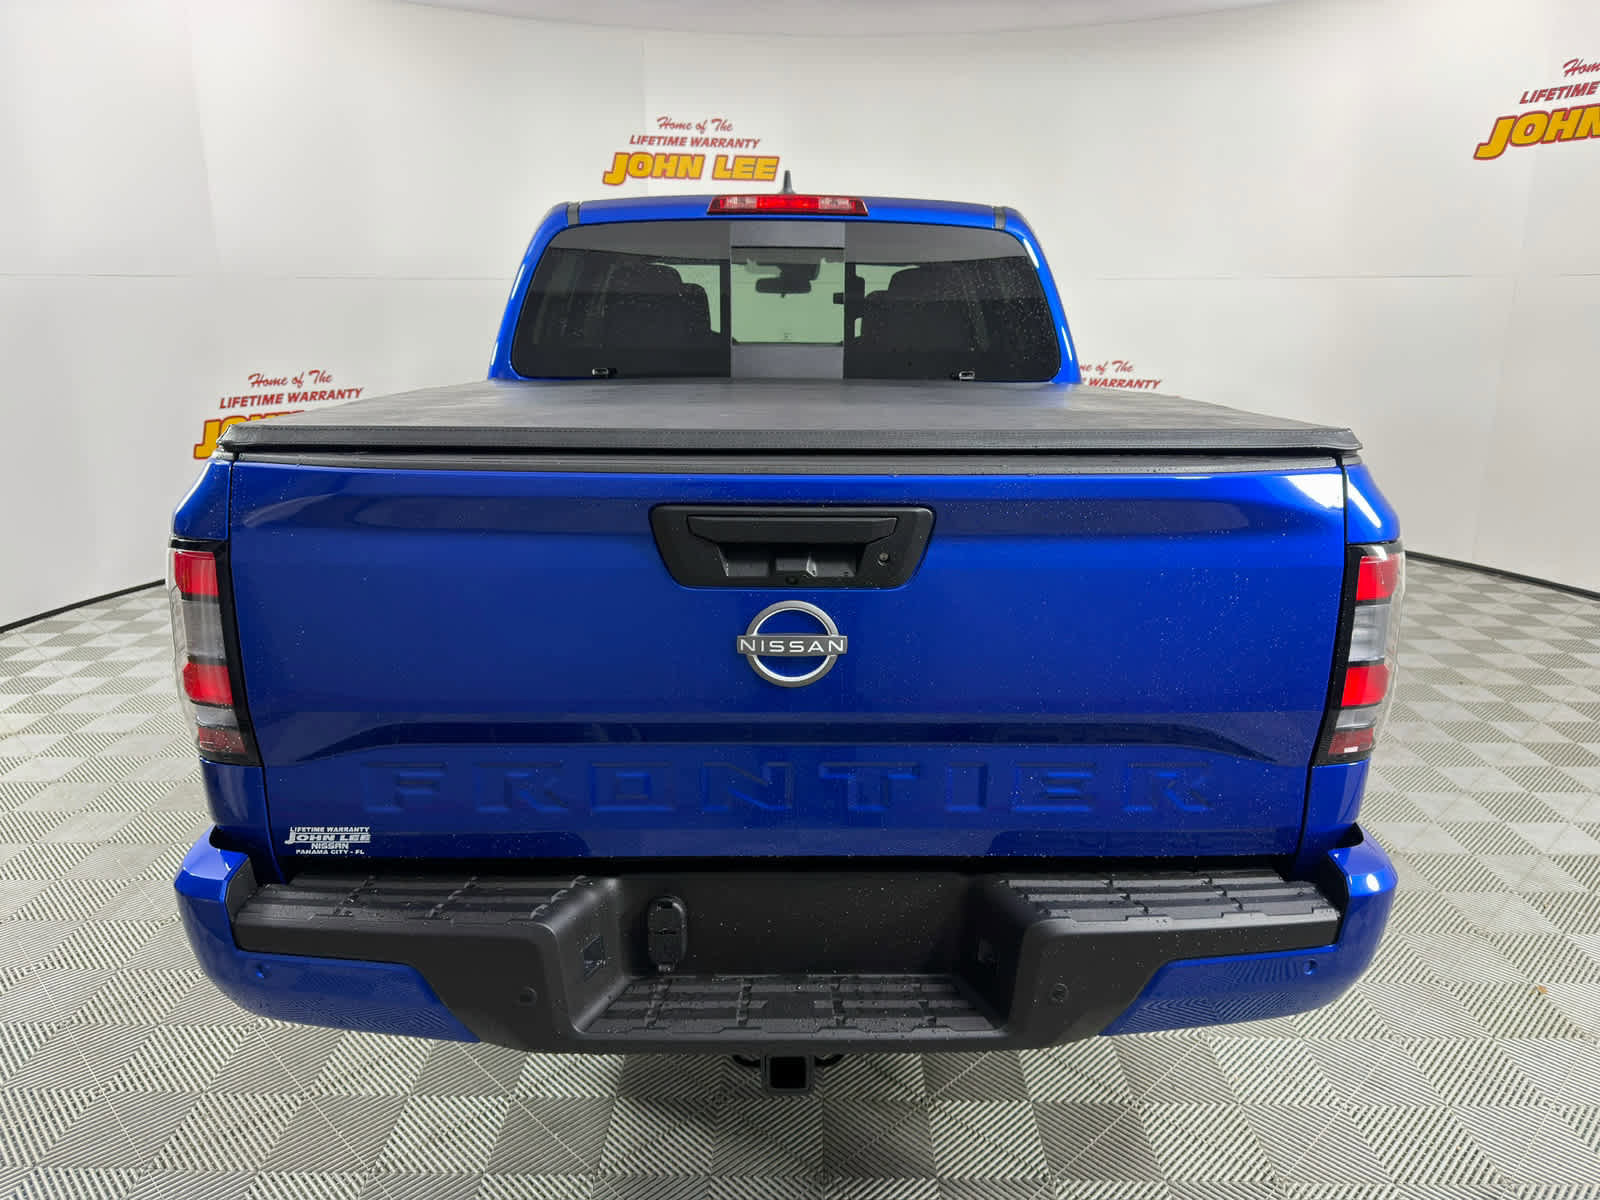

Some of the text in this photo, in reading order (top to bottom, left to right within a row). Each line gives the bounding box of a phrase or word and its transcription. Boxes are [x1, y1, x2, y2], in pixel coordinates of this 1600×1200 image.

[1519, 80, 1600, 104] LIFETIME
[656, 116, 733, 134] Home of The
[629, 134, 761, 149] LIFETIME WARRANTY
[602, 151, 780, 185] JOHN LEE
[1095, 361, 1109, 375] of
[1112, 360, 1133, 373] The
[248, 369, 333, 389] Home of The
[1088, 378, 1162, 389] WARRANTY
[219, 387, 365, 410] LIFETIME WARRANTY
[740, 639, 844, 653] NISSAN
[361, 760, 1211, 815] FRONTIER
[284, 829, 371, 845] JOHN LEE
